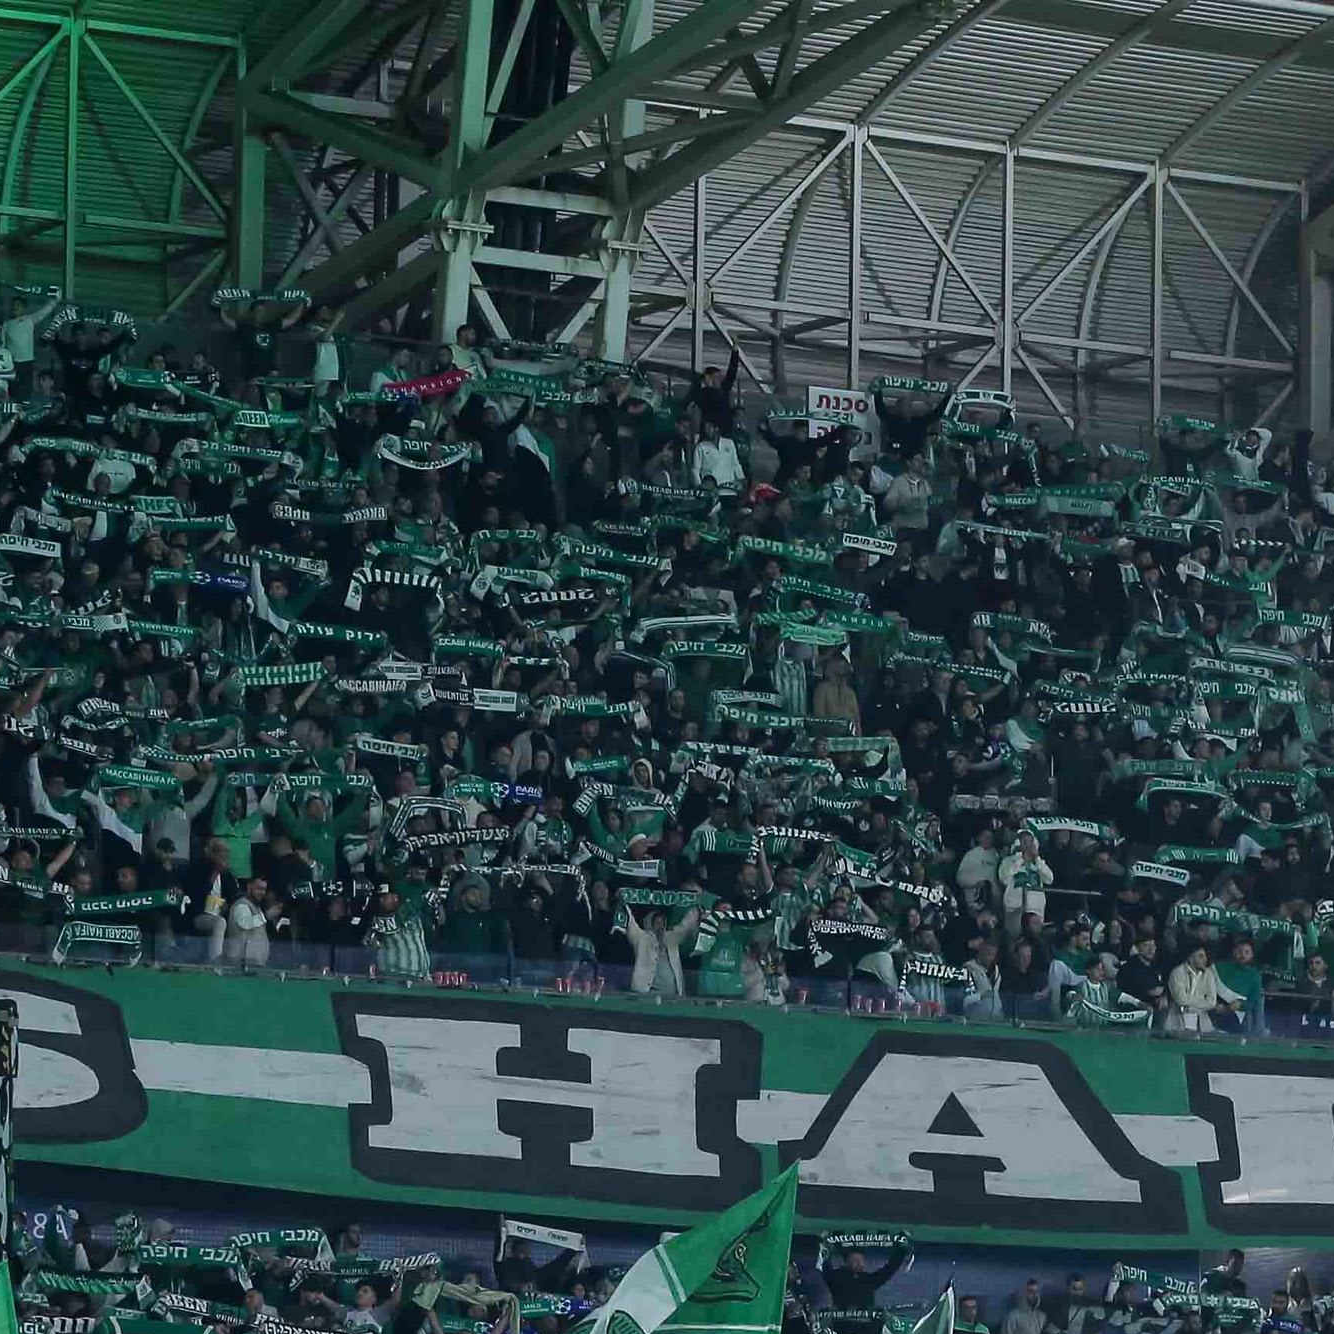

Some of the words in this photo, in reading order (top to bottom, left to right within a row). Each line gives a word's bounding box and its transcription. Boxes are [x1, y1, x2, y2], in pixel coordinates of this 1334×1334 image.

[228, 1231, 273, 1248] חיפה
[278, 1228, 318, 1242] מכבי
[143, 1244, 188, 1259] חיפה
[197, 1247, 238, 1263] מכבי
